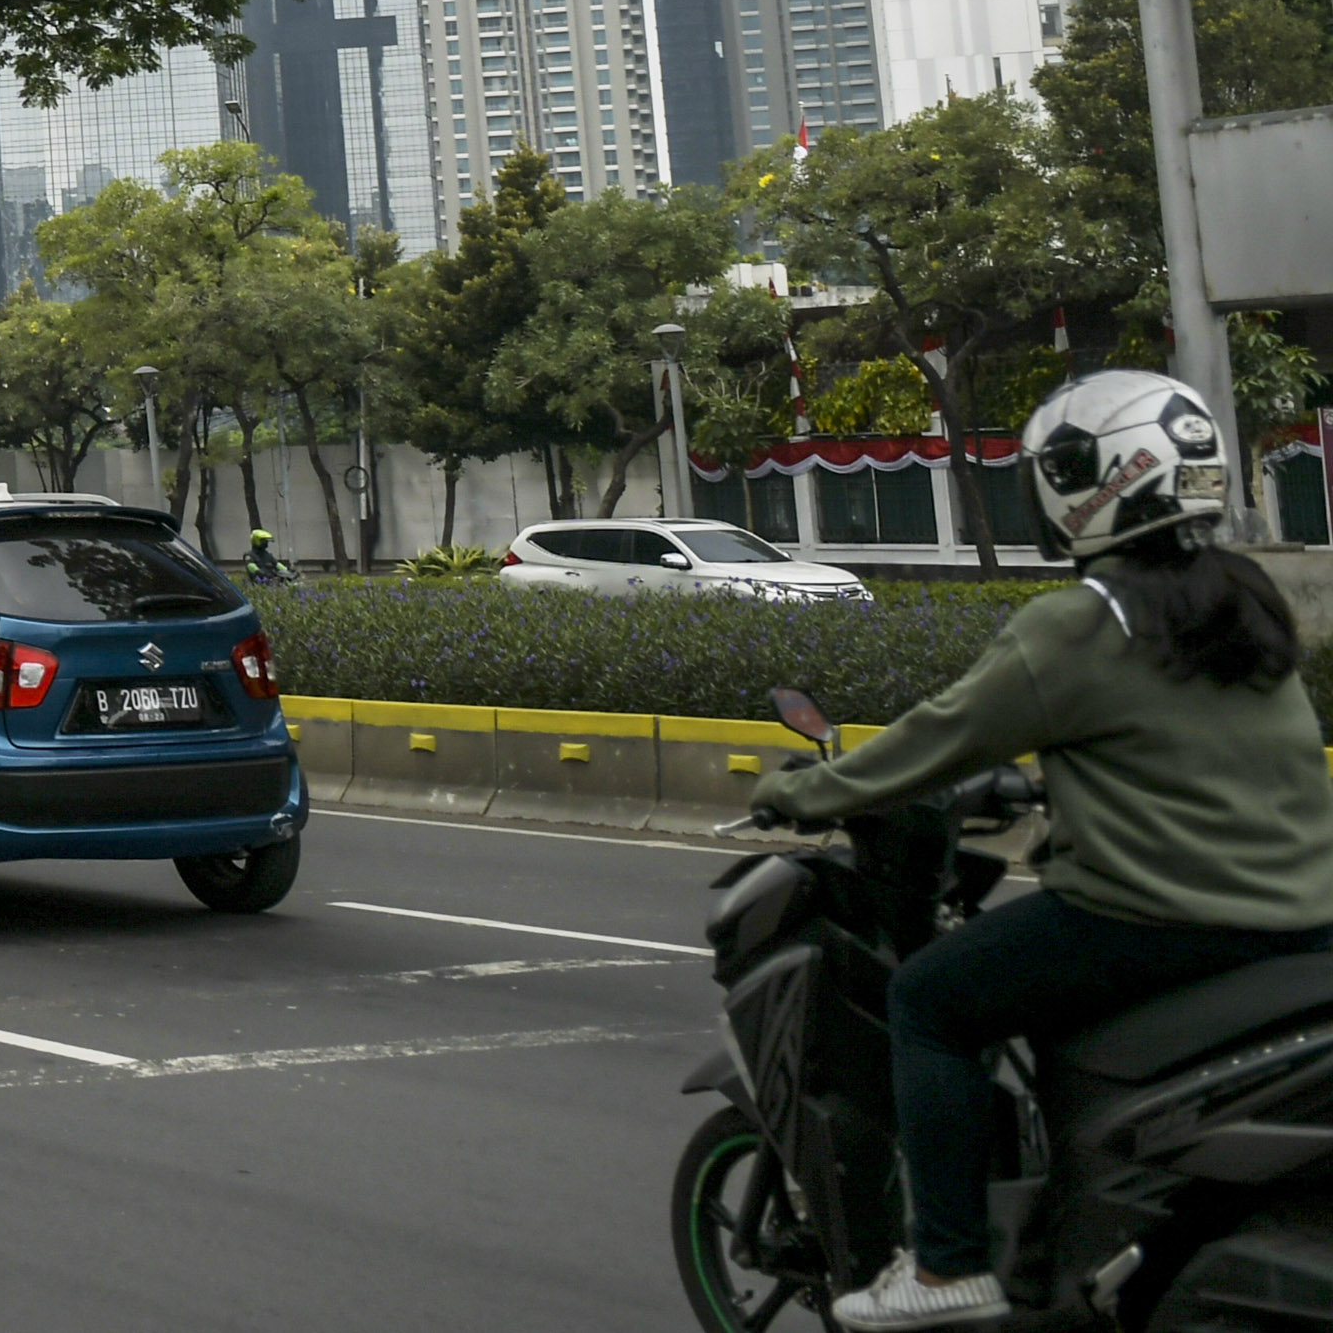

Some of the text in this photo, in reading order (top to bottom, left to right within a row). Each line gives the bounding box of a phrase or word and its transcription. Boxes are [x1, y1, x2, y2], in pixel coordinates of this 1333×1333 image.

[97, 687, 199, 712] B 2060 TZU
